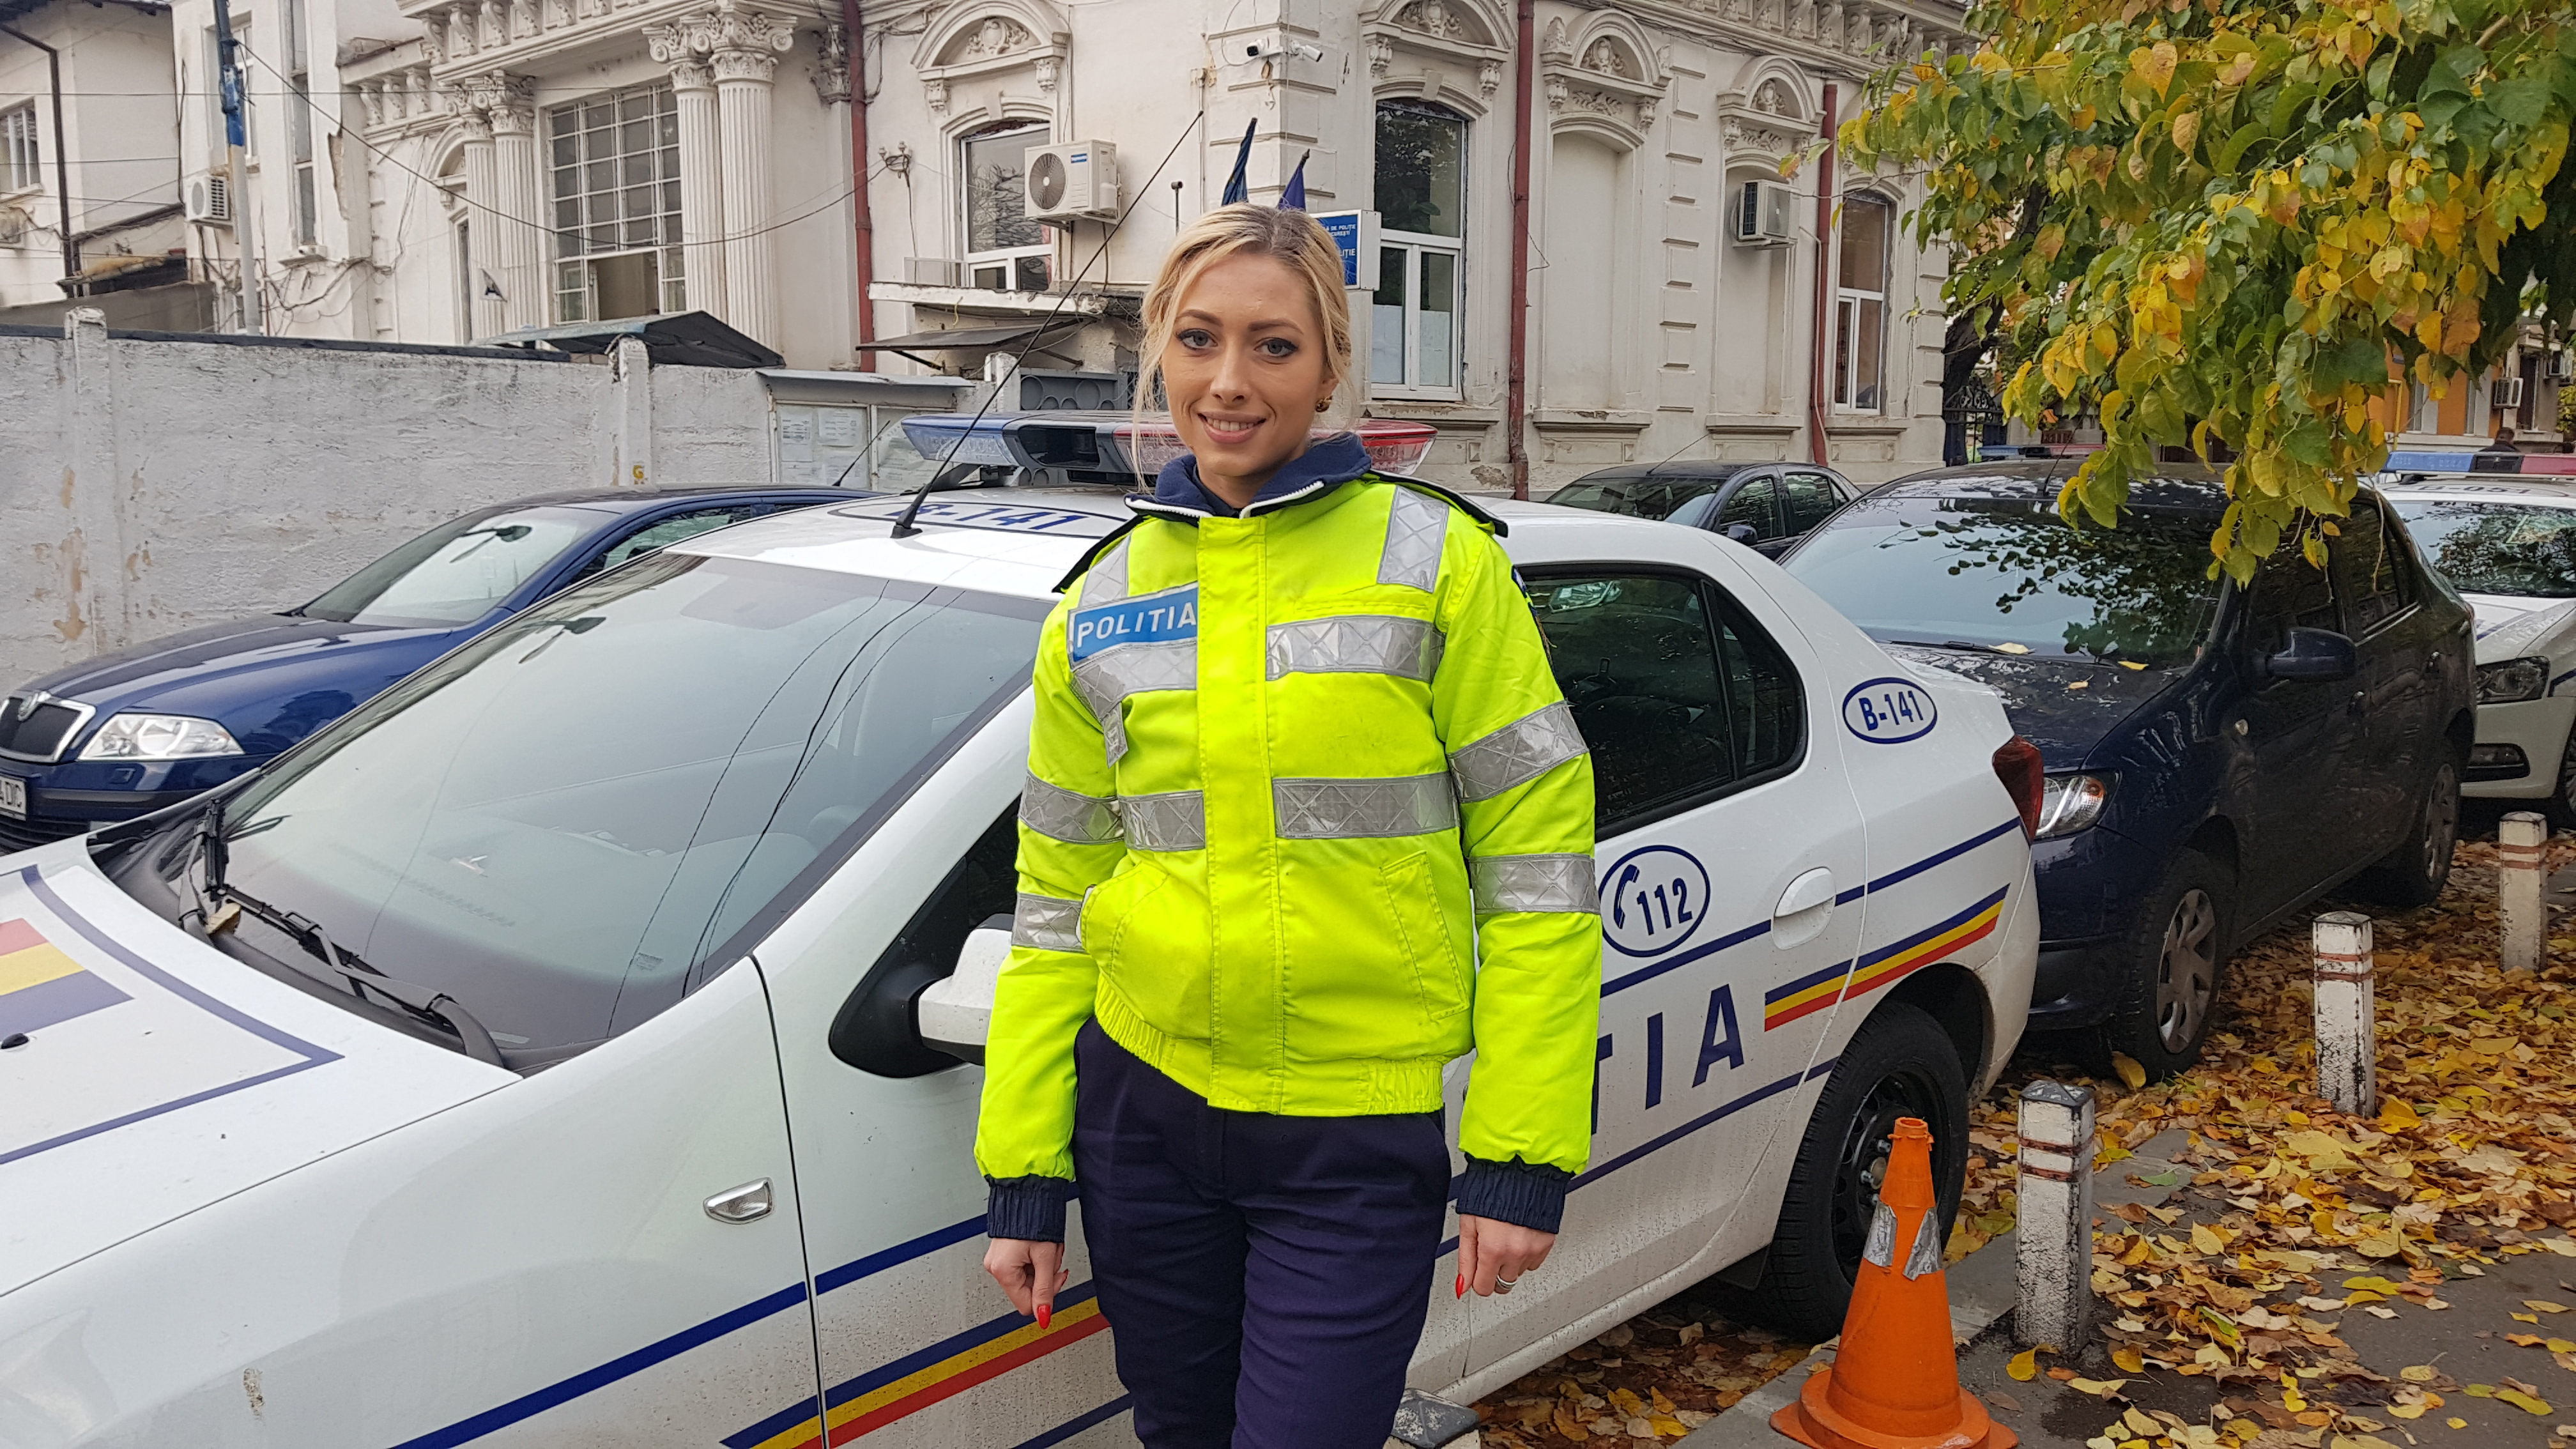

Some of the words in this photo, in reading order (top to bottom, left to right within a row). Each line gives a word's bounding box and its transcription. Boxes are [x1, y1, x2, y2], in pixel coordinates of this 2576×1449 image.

[884, 503, 1089, 530] B-141
[1077, 602, 1197, 648] POLITIA
[1859, 690, 1924, 731] B-141
[1636, 877, 1692, 936] 112
